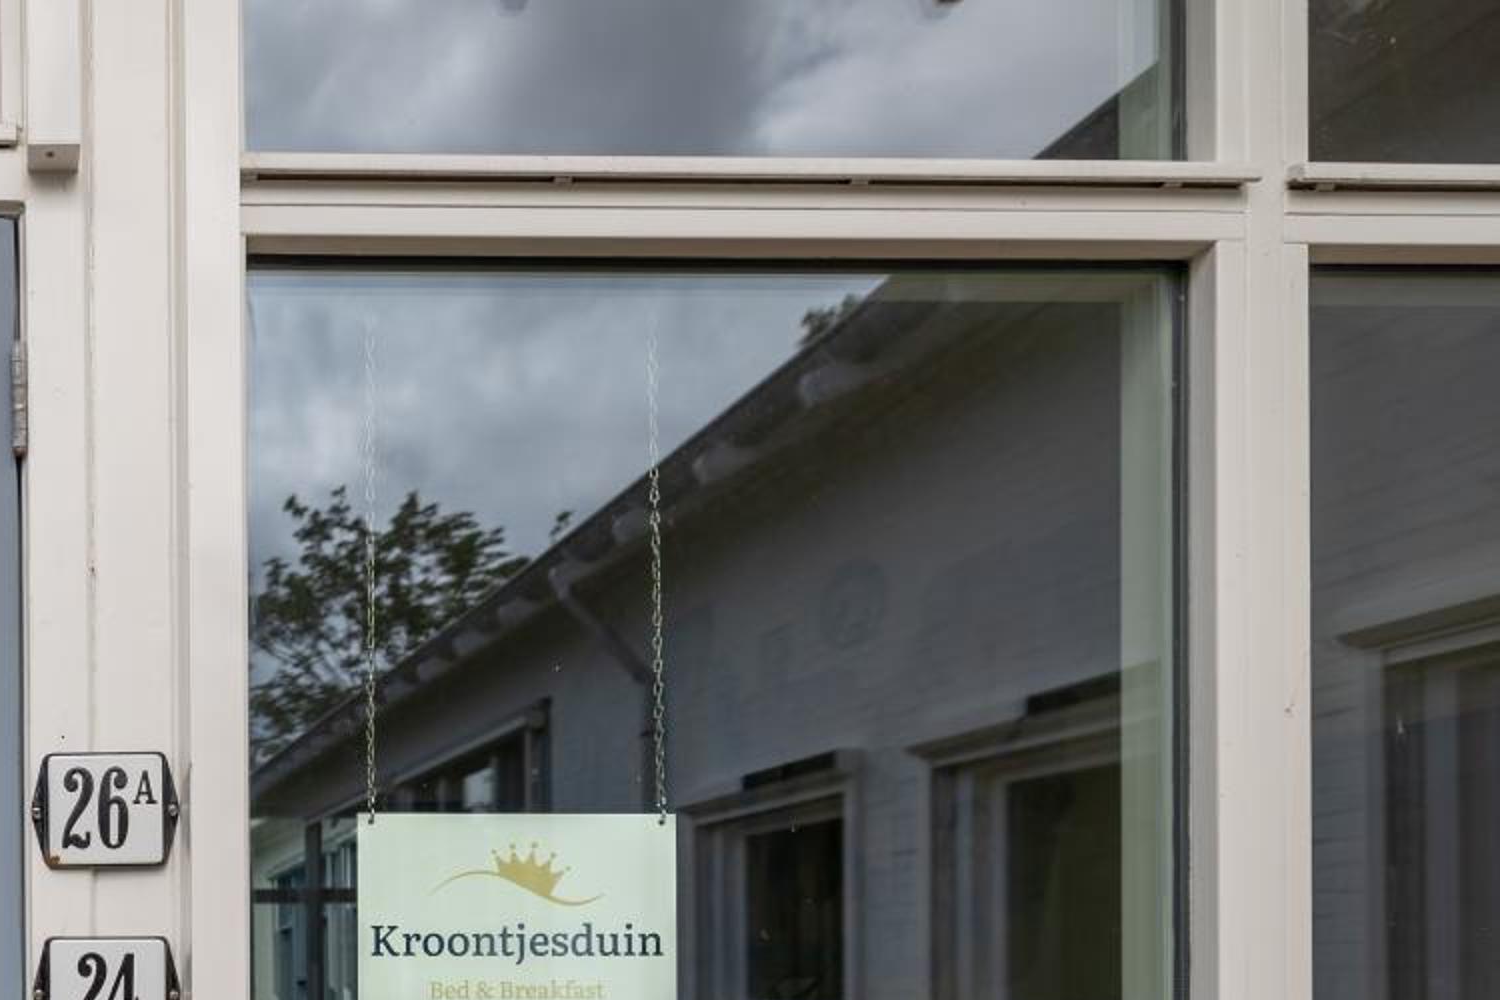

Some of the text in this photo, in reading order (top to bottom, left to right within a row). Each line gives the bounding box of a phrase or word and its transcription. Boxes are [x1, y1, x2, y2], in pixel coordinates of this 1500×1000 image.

[370, 922, 664, 966] Kroontjesduin
[430, 979, 605, 1000] Bed & Breakfast
